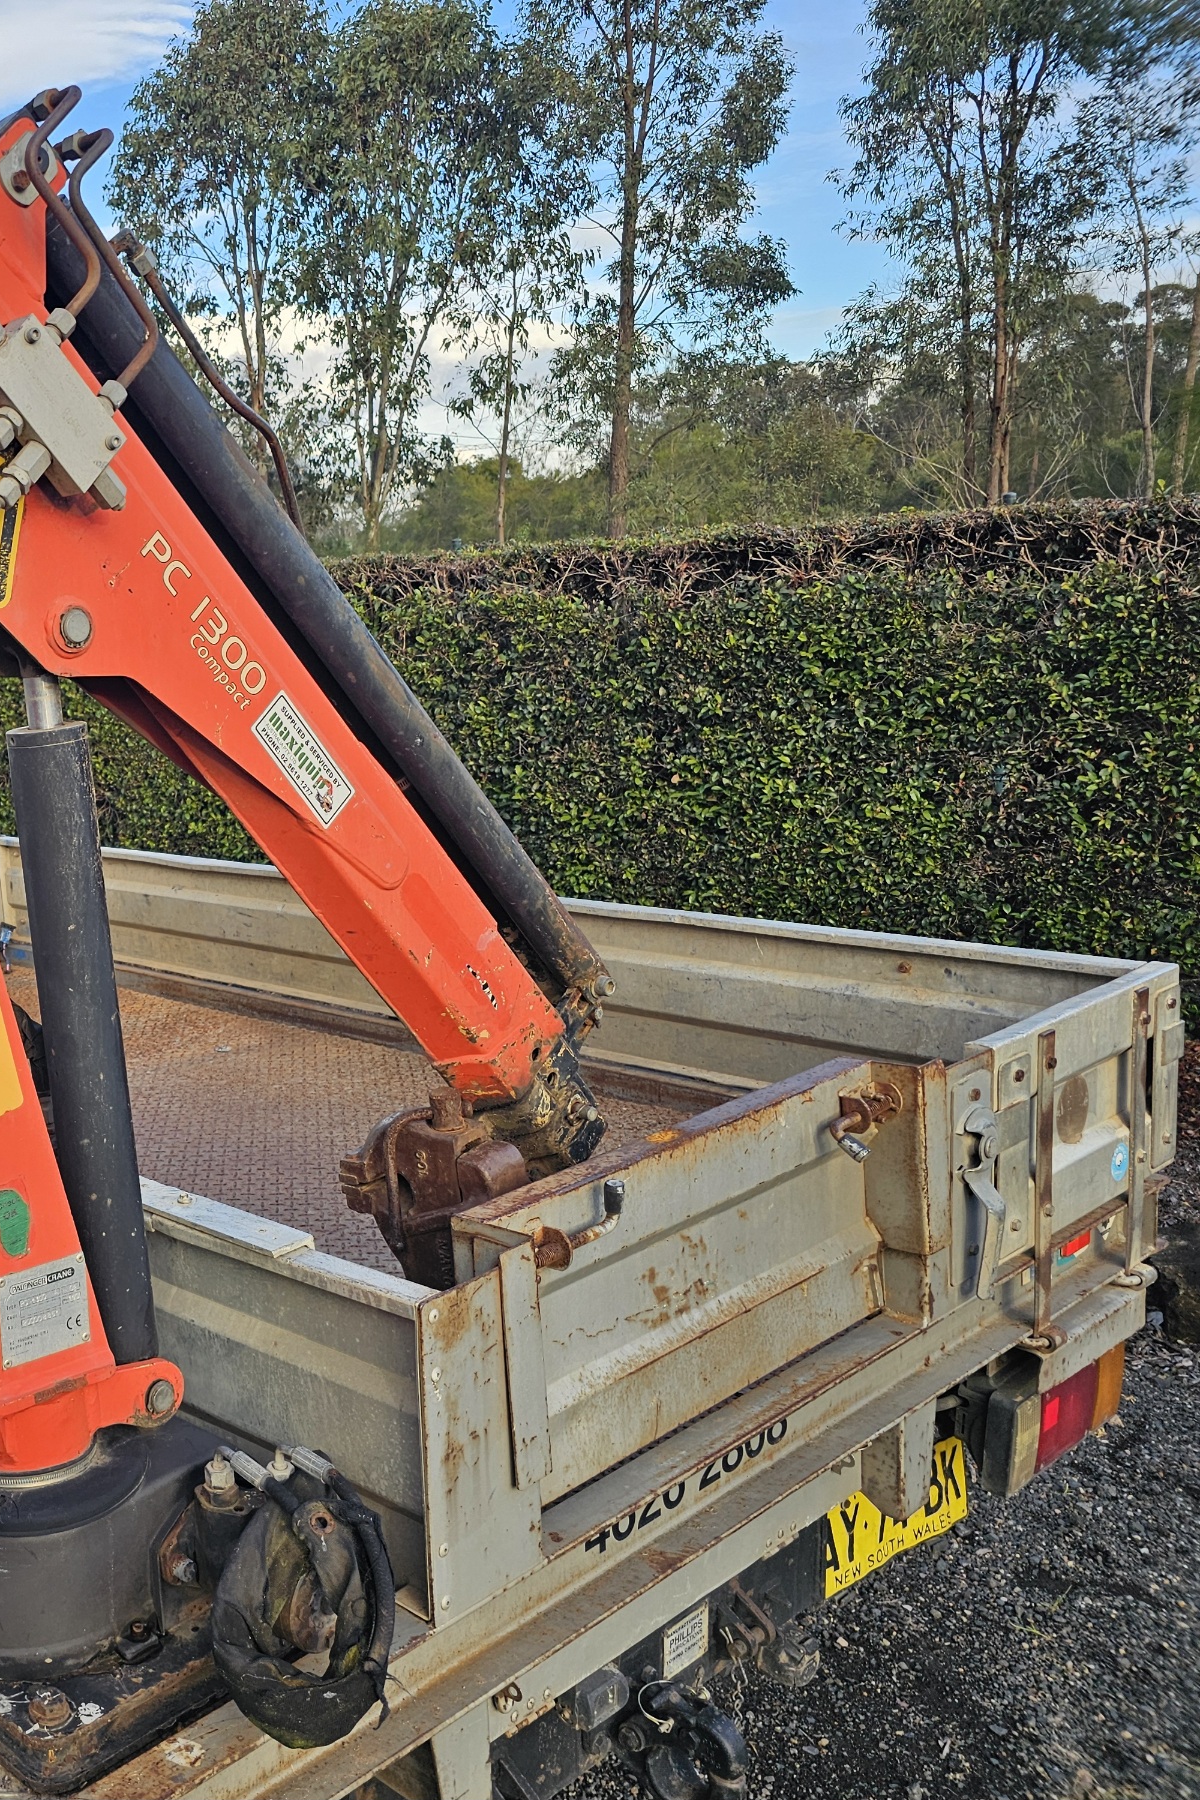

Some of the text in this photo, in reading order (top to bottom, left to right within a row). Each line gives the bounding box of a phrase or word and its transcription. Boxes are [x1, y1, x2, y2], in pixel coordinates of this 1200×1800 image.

[140, 530, 267, 695] PC 1300
[190, 633, 251, 711] Compact
[261, 727, 312, 797] PHONE: 02 9618 1277
[265, 722, 284, 747] AUSTRALIA
[268, 711, 329, 789] maxiquip
[280, 705, 305, 740] SUPPLIED
[309, 745, 334, 779] SERVICED
[332, 777, 341, 789] BY
[834, 1562, 861, 1589] NEW
[867, 1534, 905, 1568] SOUTH
[912, 1511, 952, 1542] WALES
[666, 1651, 684, 1666] TOWING
[669, 1618, 703, 1649] PHILLIPS
